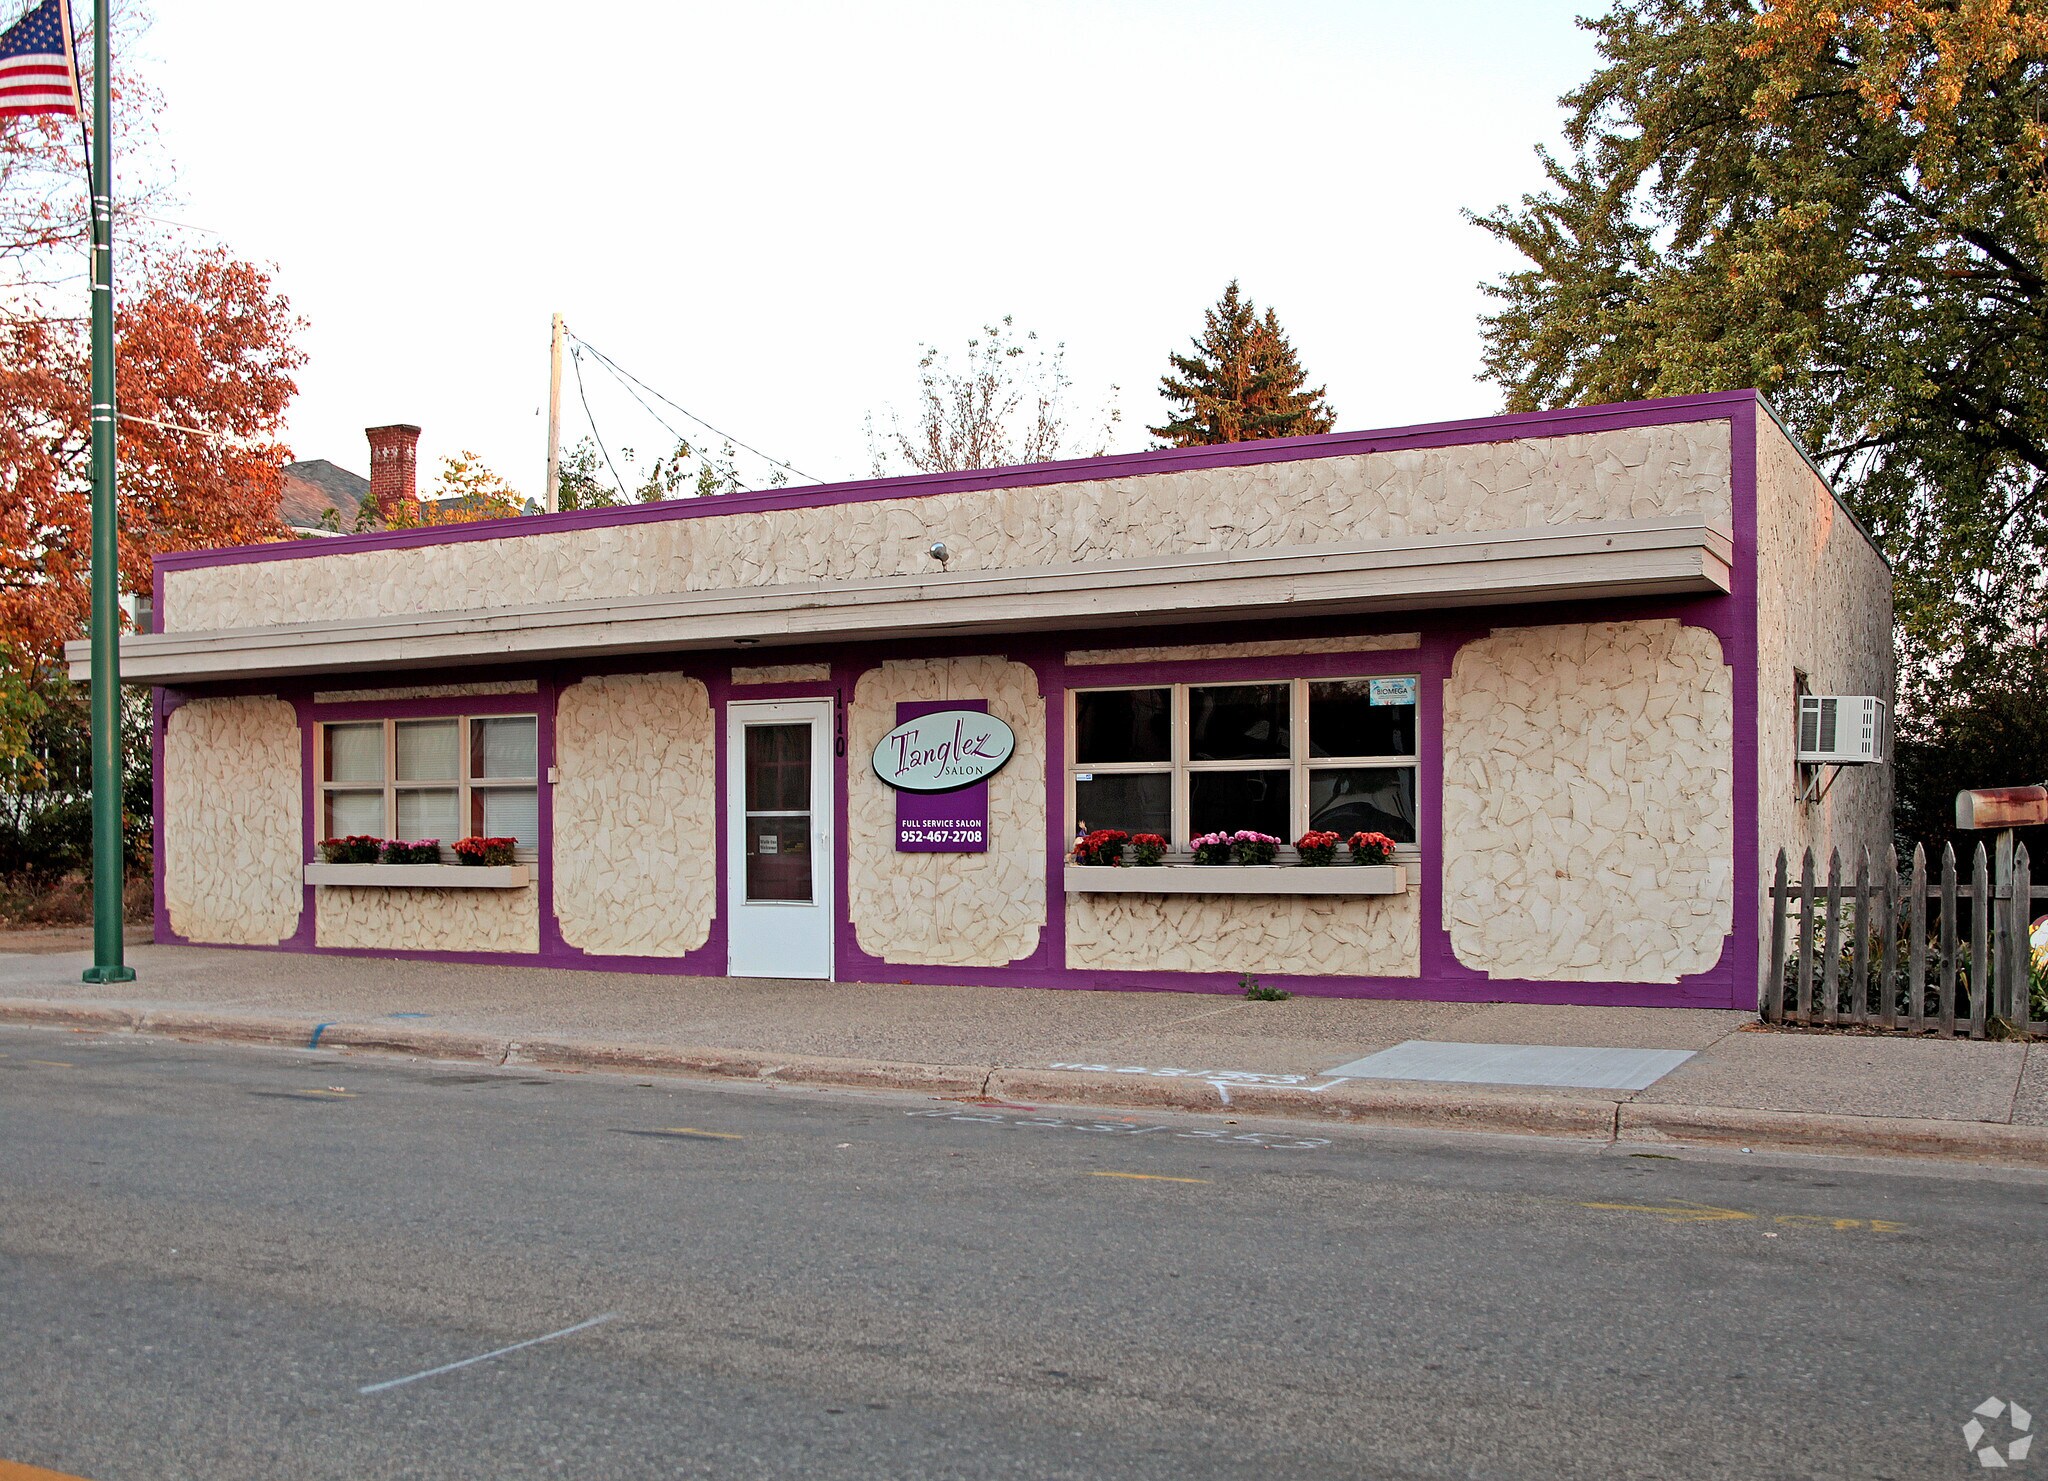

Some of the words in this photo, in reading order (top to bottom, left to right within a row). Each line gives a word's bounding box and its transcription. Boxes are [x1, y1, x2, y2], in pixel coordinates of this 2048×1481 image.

[1376, 687, 1408, 695] BIOMEGA
[836, 688, 845, 757] 110
[891, 718, 1005, 778] Tanglez
[945, 765, 983, 775] SALON
[902, 819, 920, 828] FULL
[922, 819, 954, 828] SERVICE
[955, 819, 982, 828] SALON
[901, 830, 982, 843] 952-467-2708
